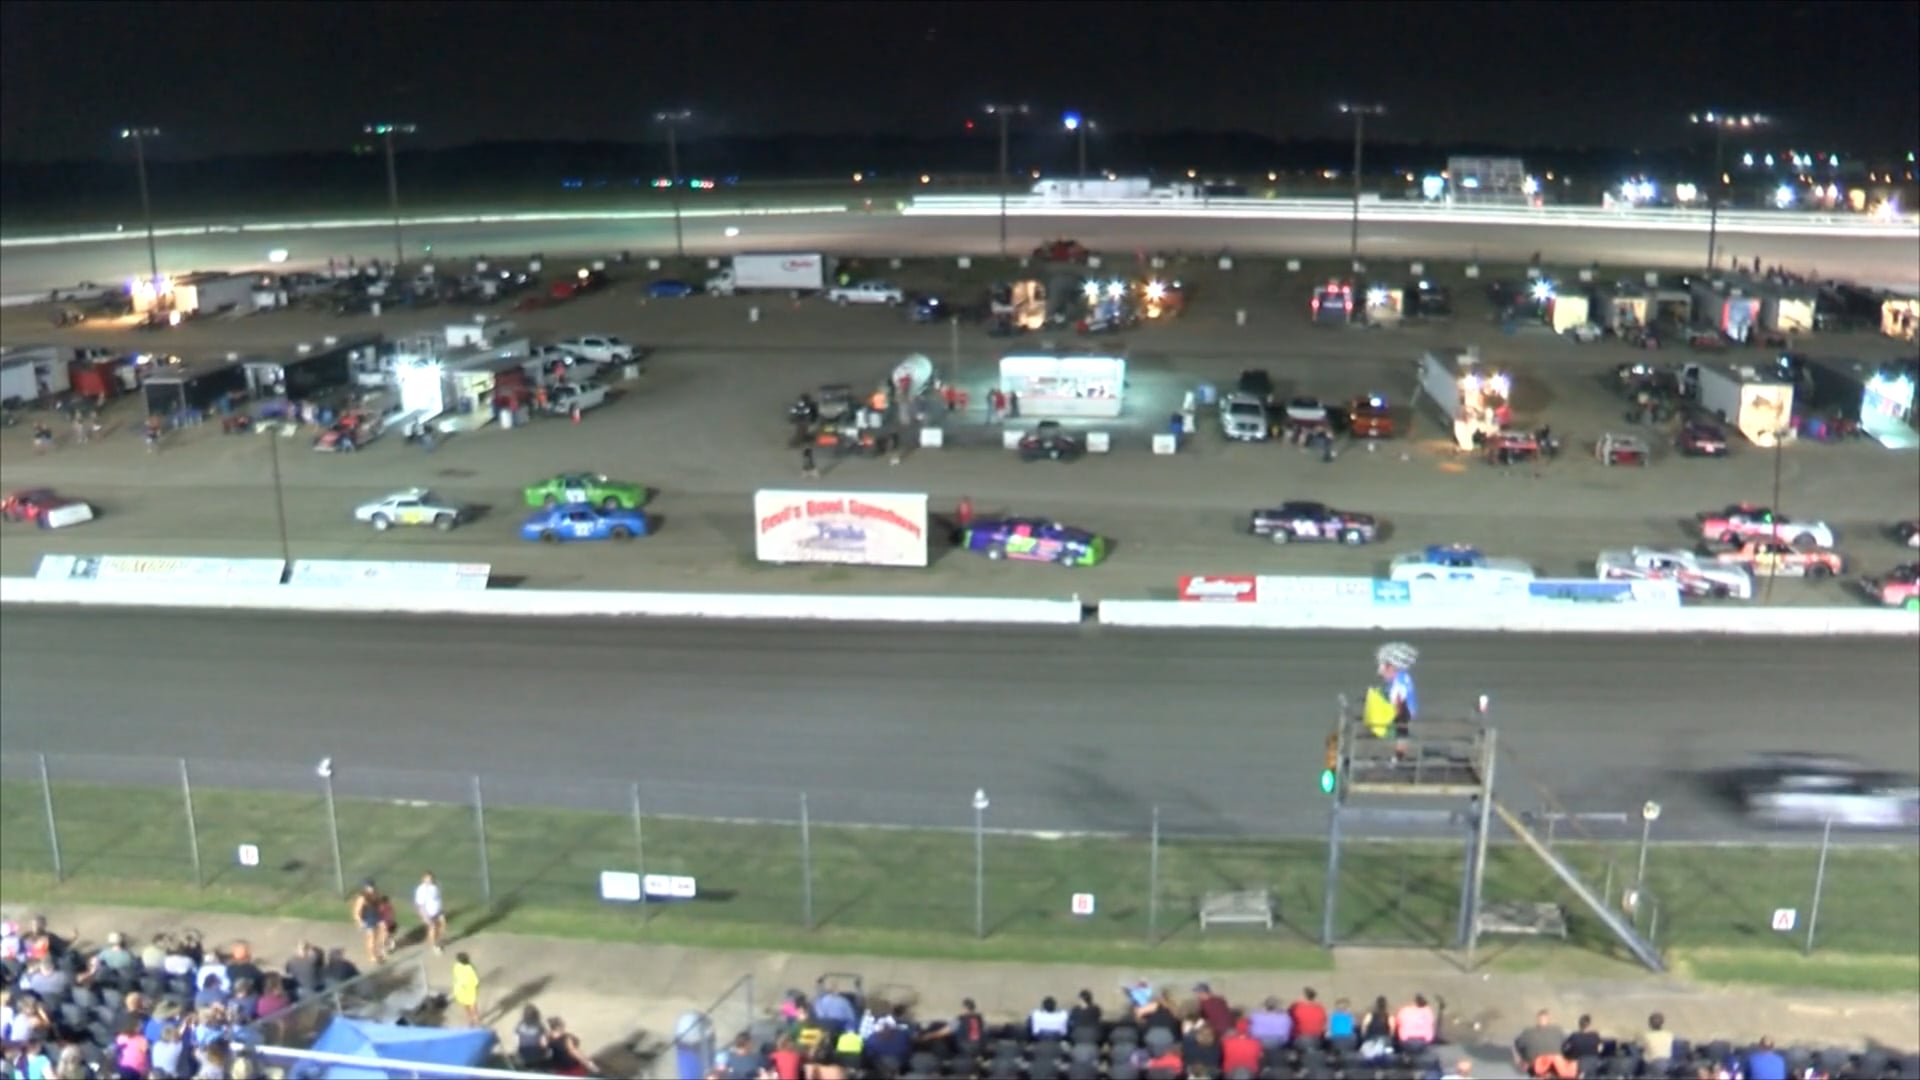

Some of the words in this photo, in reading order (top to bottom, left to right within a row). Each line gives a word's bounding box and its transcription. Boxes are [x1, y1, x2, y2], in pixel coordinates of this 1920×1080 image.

[761, 505, 802, 534] Devil's
[806, 499, 844, 517] Bowl
[849, 499, 921, 540] Speedway
